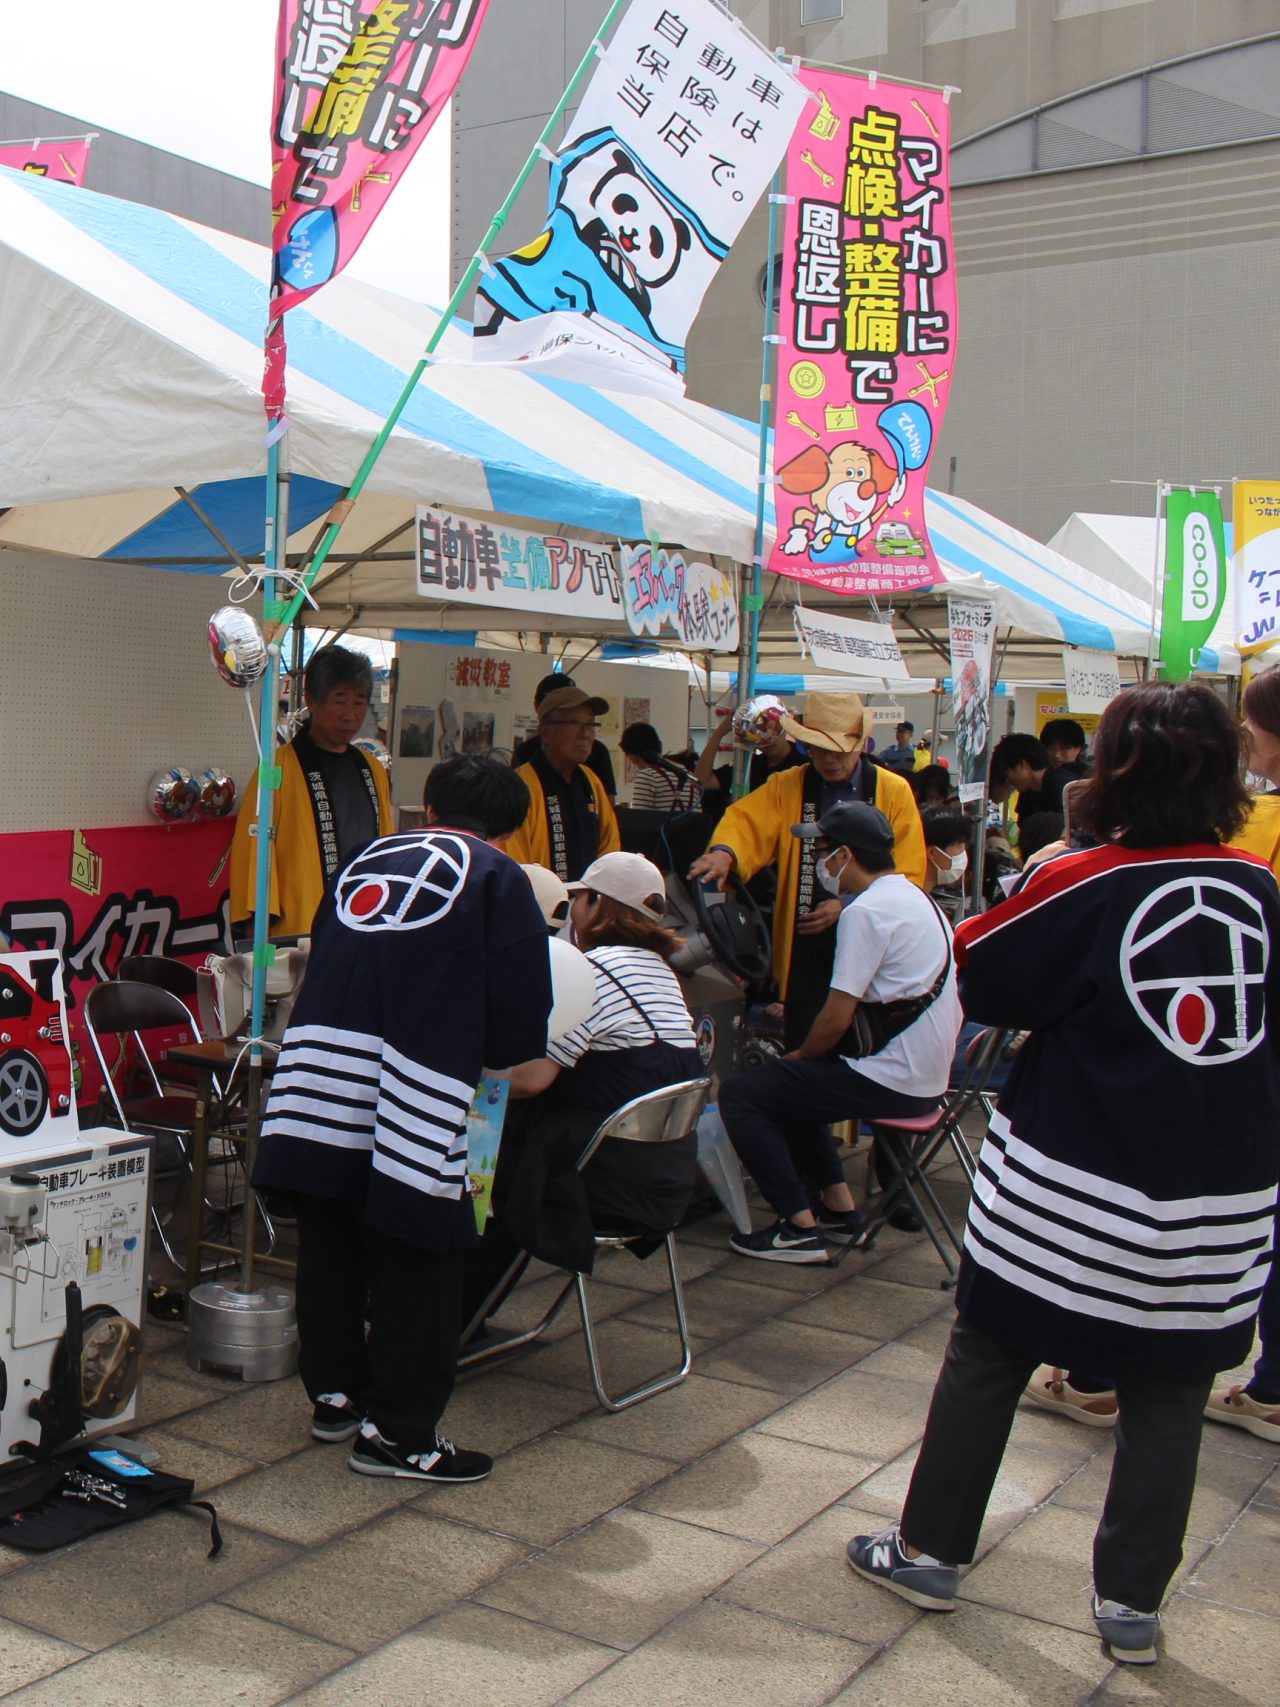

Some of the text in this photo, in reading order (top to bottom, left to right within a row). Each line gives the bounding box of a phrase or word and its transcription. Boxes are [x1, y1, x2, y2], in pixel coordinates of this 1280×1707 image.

[278, 0, 353, 144] 返し
[635, 44, 763, 143] 保険は
[653, 9, 785, 110] 自動車
[794, 201, 841, 351] 恩返し
[843, 108, 901, 401] 点検・整備で
[900, 138, 947, 353] マイカーに
[8, 896, 234, 998] マイカー
